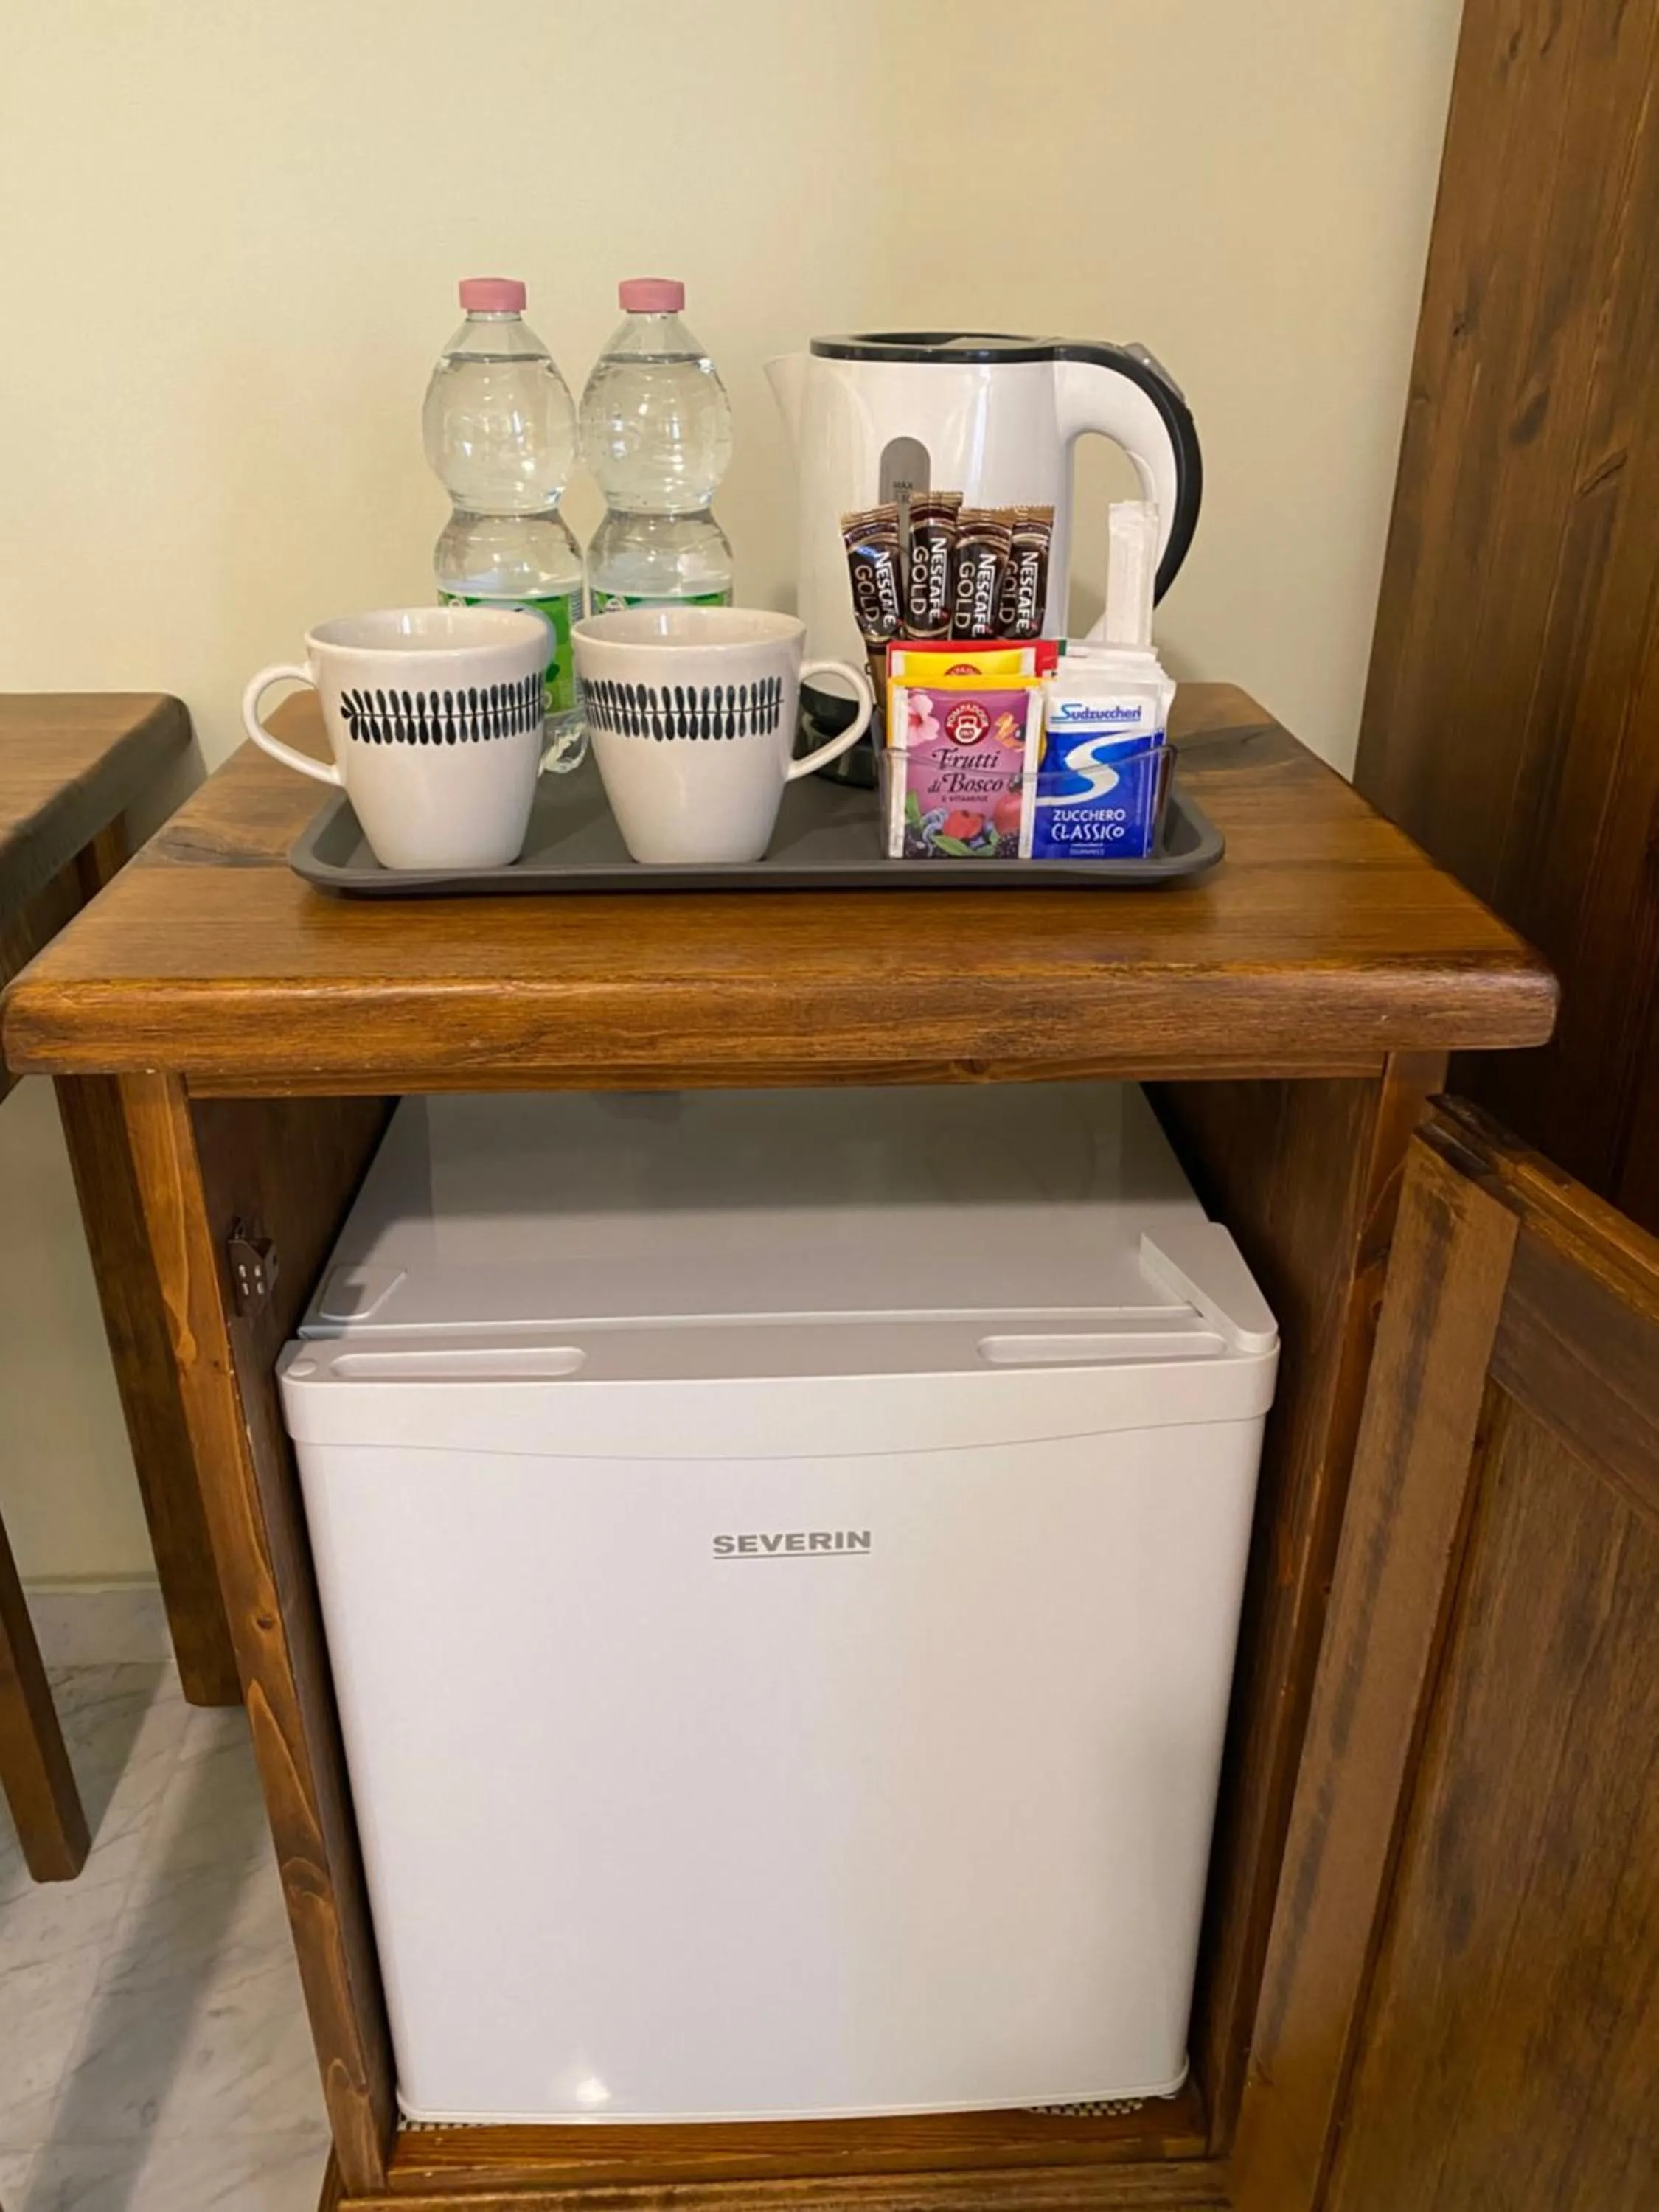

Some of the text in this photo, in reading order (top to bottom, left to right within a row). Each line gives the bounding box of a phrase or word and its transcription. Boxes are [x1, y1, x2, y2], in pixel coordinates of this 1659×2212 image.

[910, 546, 929, 615] GOLD
[855, 565, 880, 622] GOLD
[955, 561, 975, 629] GOLD
[1050, 703, 1142, 721] Sudzuccheri
[931, 747, 1001, 770] Frutti
[927, 773, 1004, 794] di Bosco
[1052, 808, 1127, 822] ZUCCHERO
[1051, 823, 1125, 841] CLASSICO
[712, 1531, 872, 1554] SEVERIN
